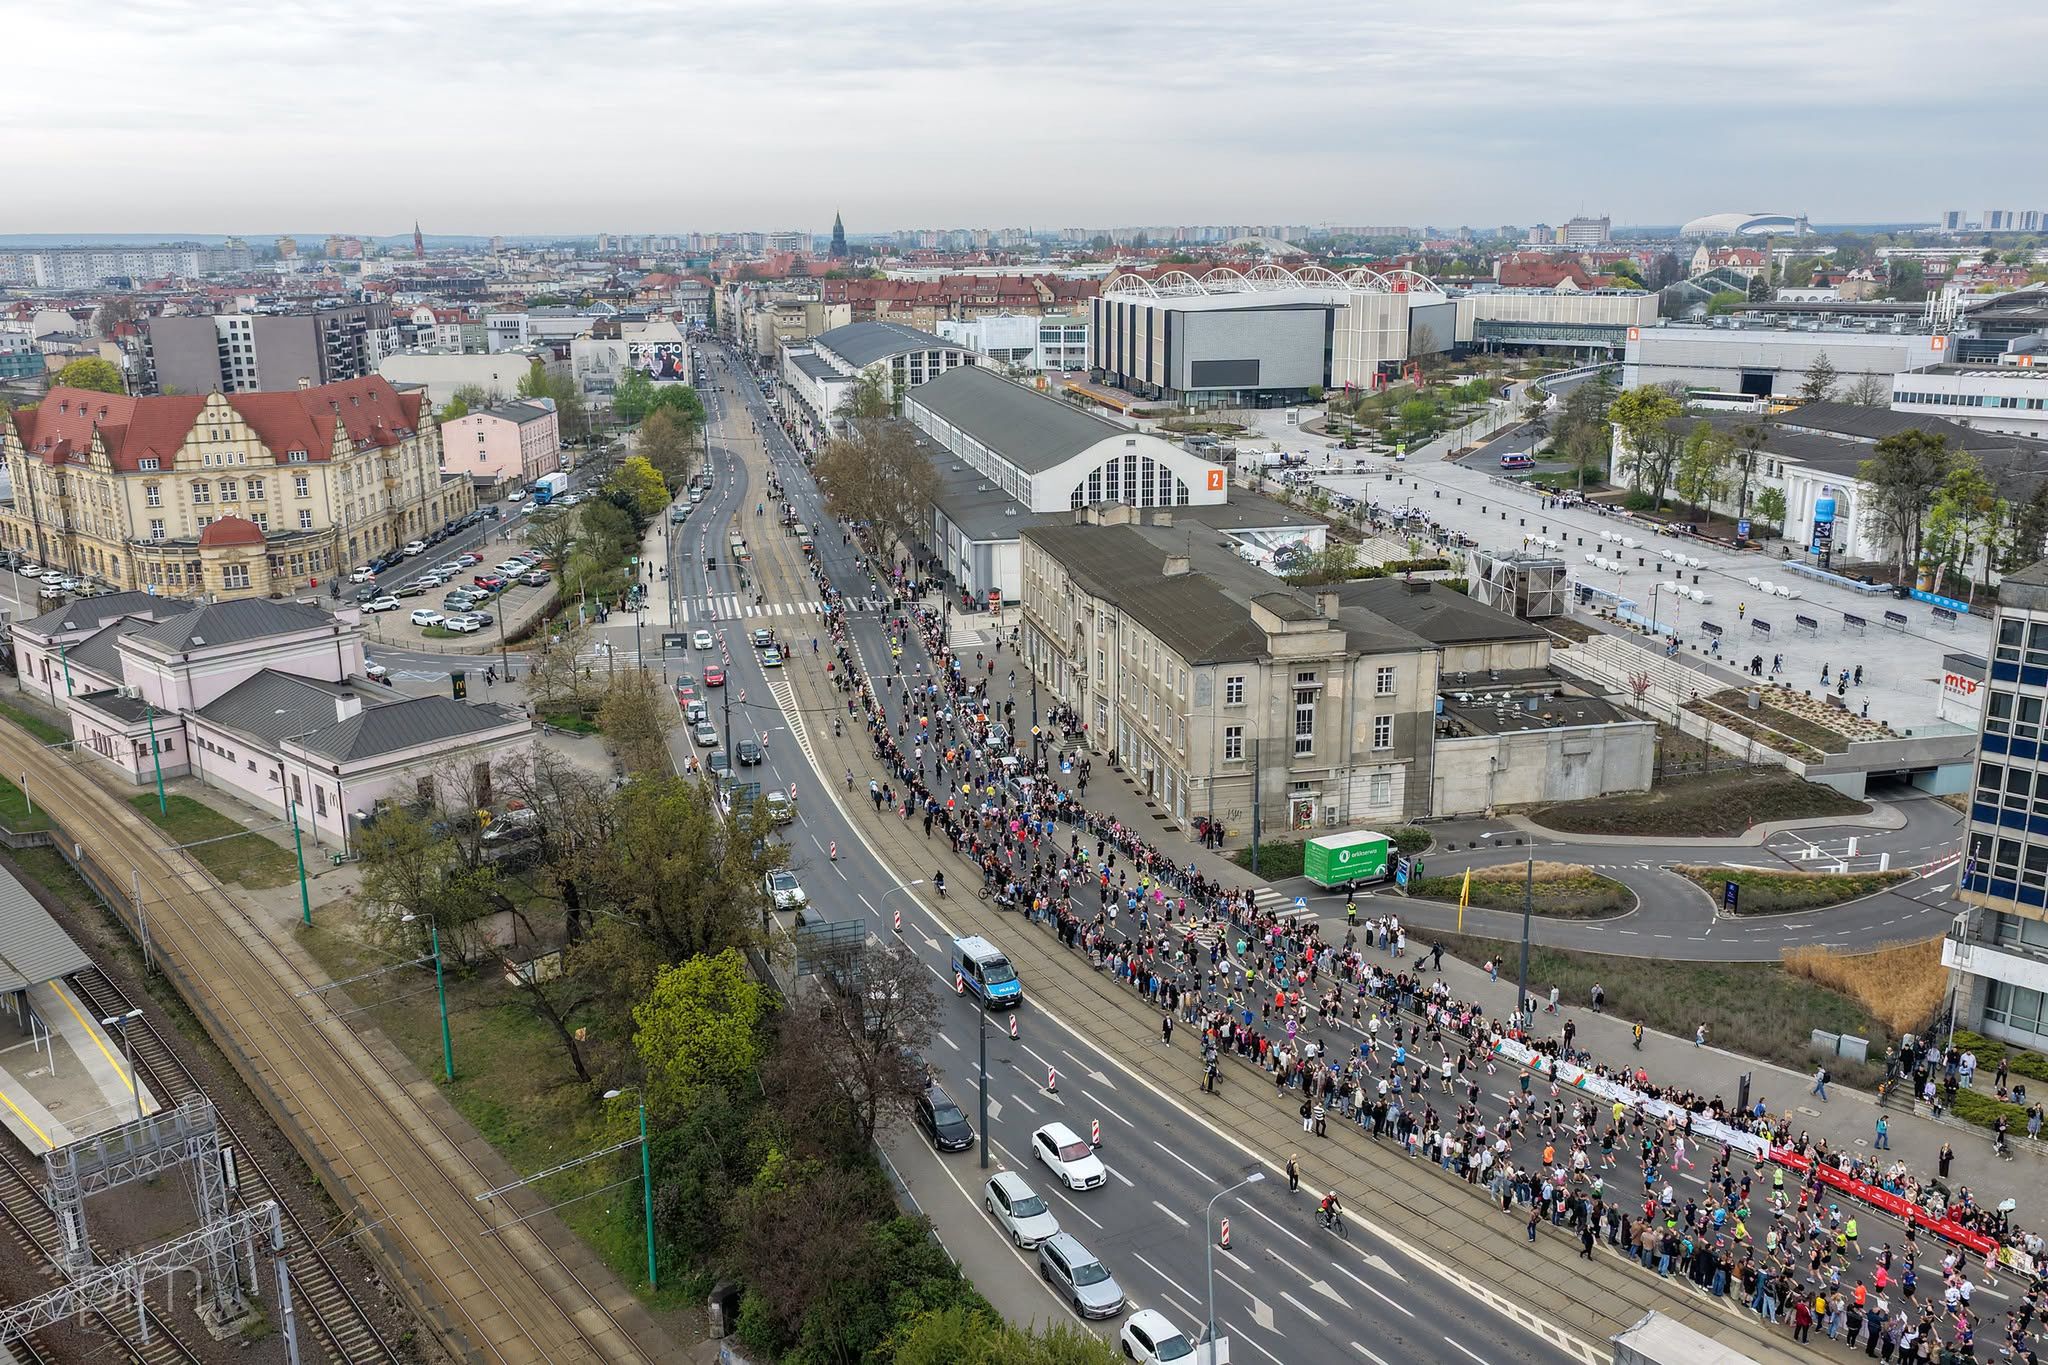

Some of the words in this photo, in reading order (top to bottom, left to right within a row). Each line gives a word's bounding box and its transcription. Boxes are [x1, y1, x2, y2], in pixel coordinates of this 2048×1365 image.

[629, 342, 682, 354] zalando
[1212, 473, 1219, 487] 2
[1945, 674, 1977, 694] mtp
